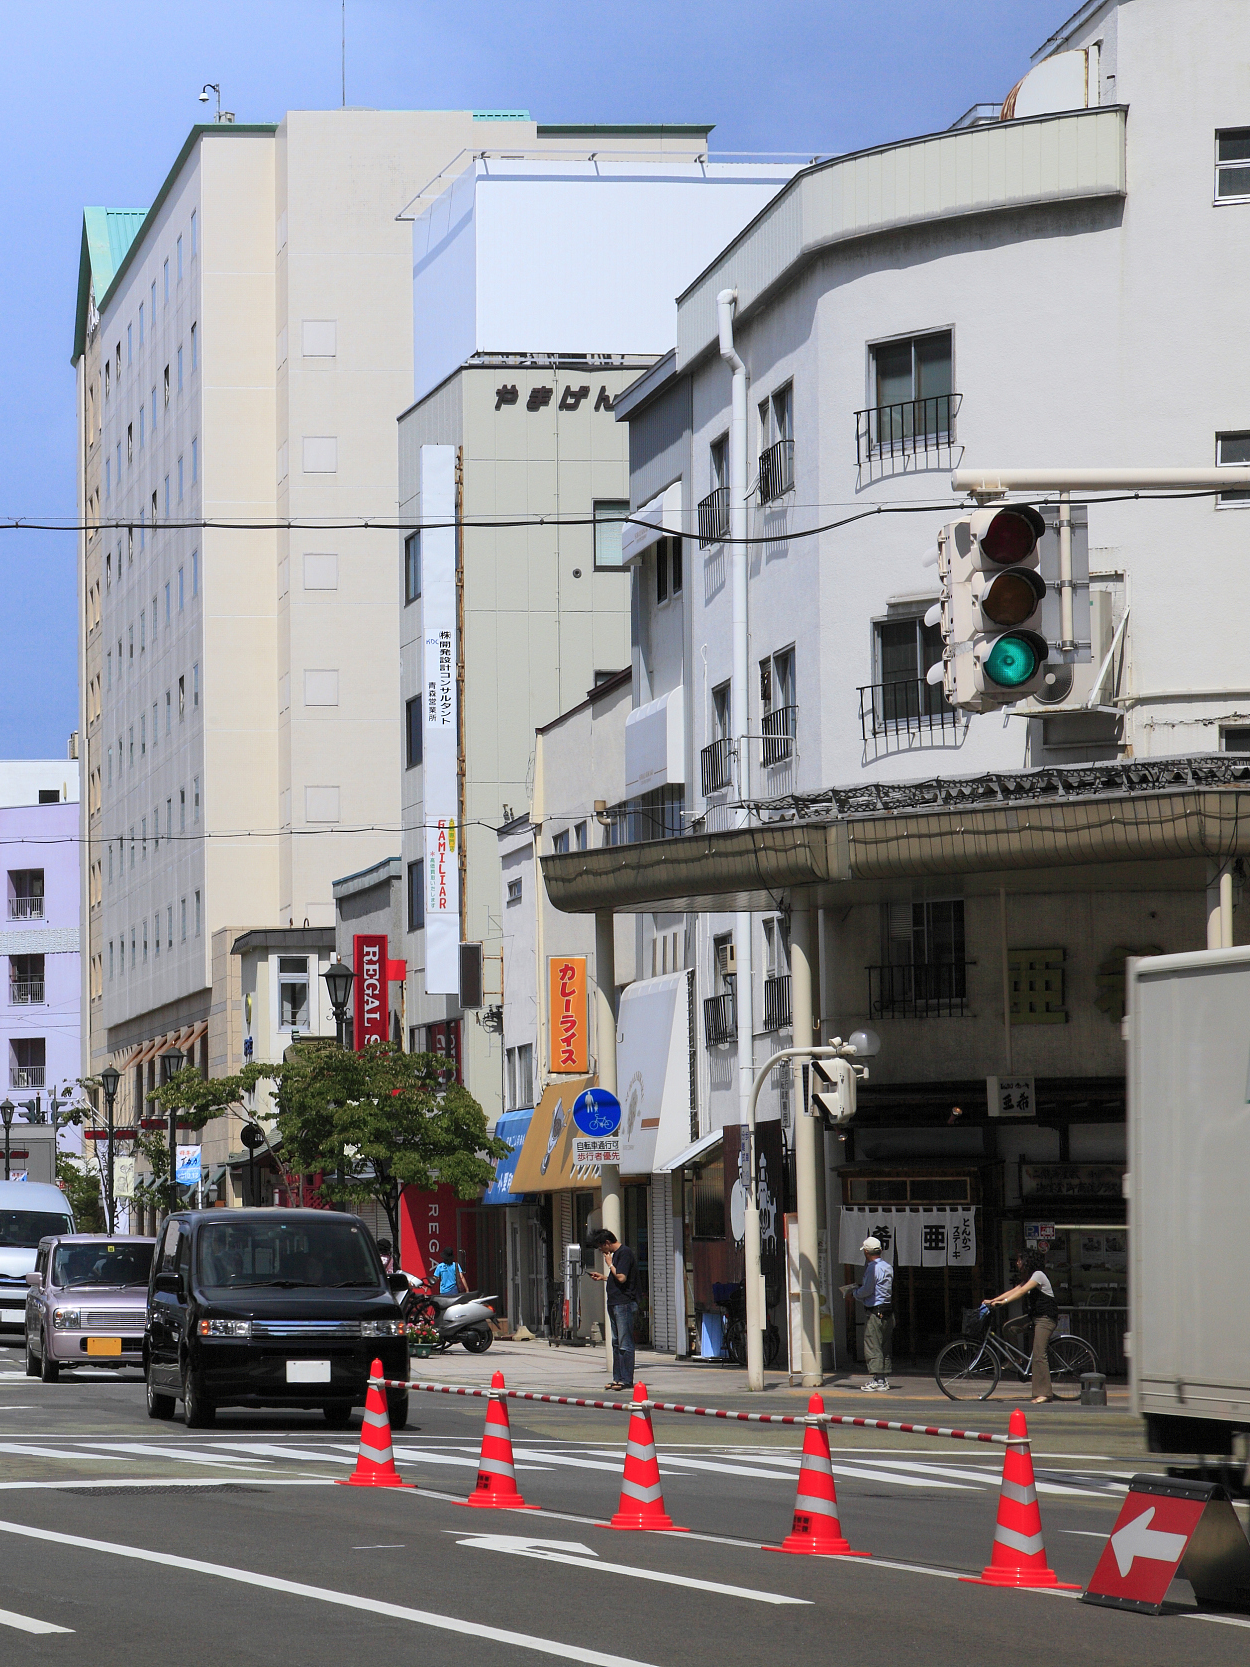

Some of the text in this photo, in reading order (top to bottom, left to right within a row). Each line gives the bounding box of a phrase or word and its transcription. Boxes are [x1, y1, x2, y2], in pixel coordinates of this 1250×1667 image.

[438, 819, 447, 910] FAMILIAR
[363, 944, 380, 1027] REGAL
[558, 963, 578, 1066] カレーライス
[576, 1140, 620, 1151] 自転車通行可
[577, 1151, 621, 1162] 歩行者優先
[952, 1225, 961, 1260] ステーキ
[961, 1217, 972, 1252] とんかつ
